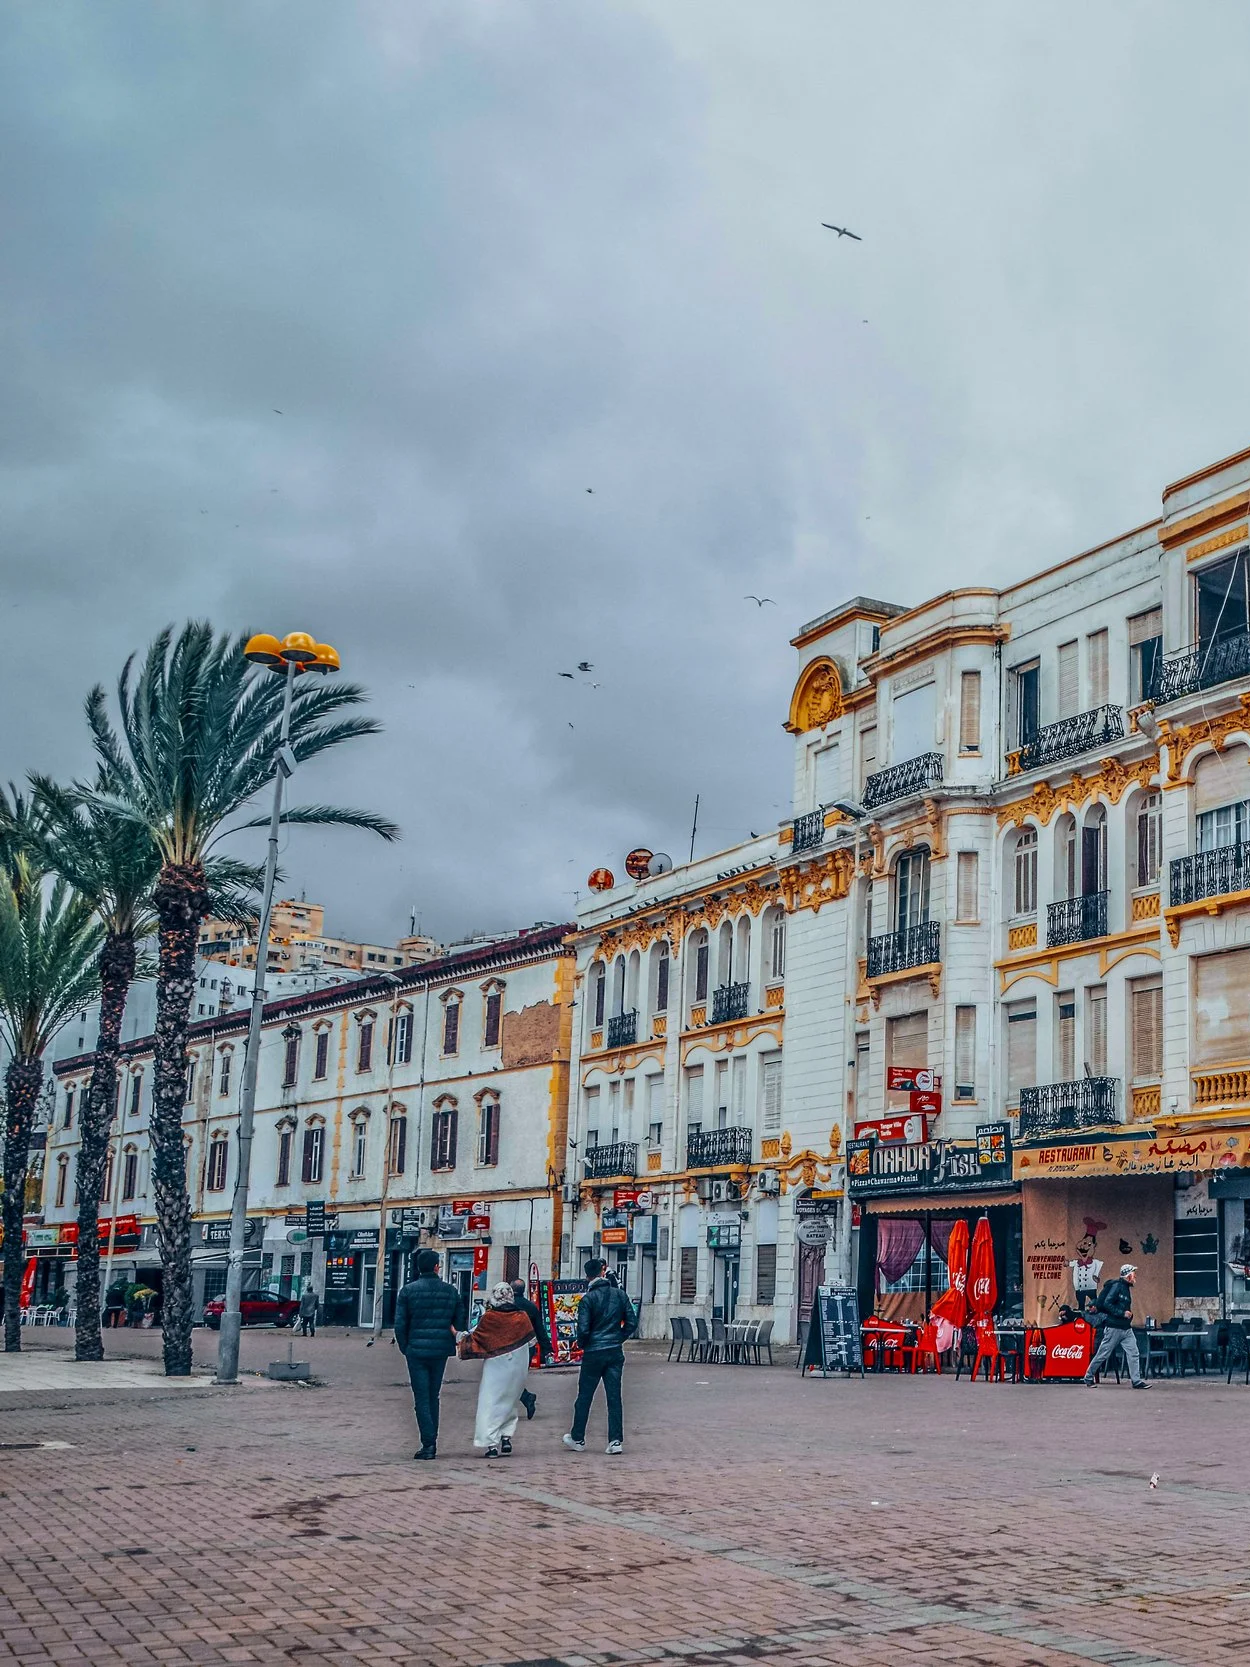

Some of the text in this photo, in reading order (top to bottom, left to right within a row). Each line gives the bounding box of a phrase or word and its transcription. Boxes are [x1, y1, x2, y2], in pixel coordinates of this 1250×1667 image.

[1039, 1146, 1097, 1164] RESTAURANT
[1027, 1255, 1065, 1263] BIENVENIDOS
[1031, 1263, 1062, 1271] BIENVENUE
